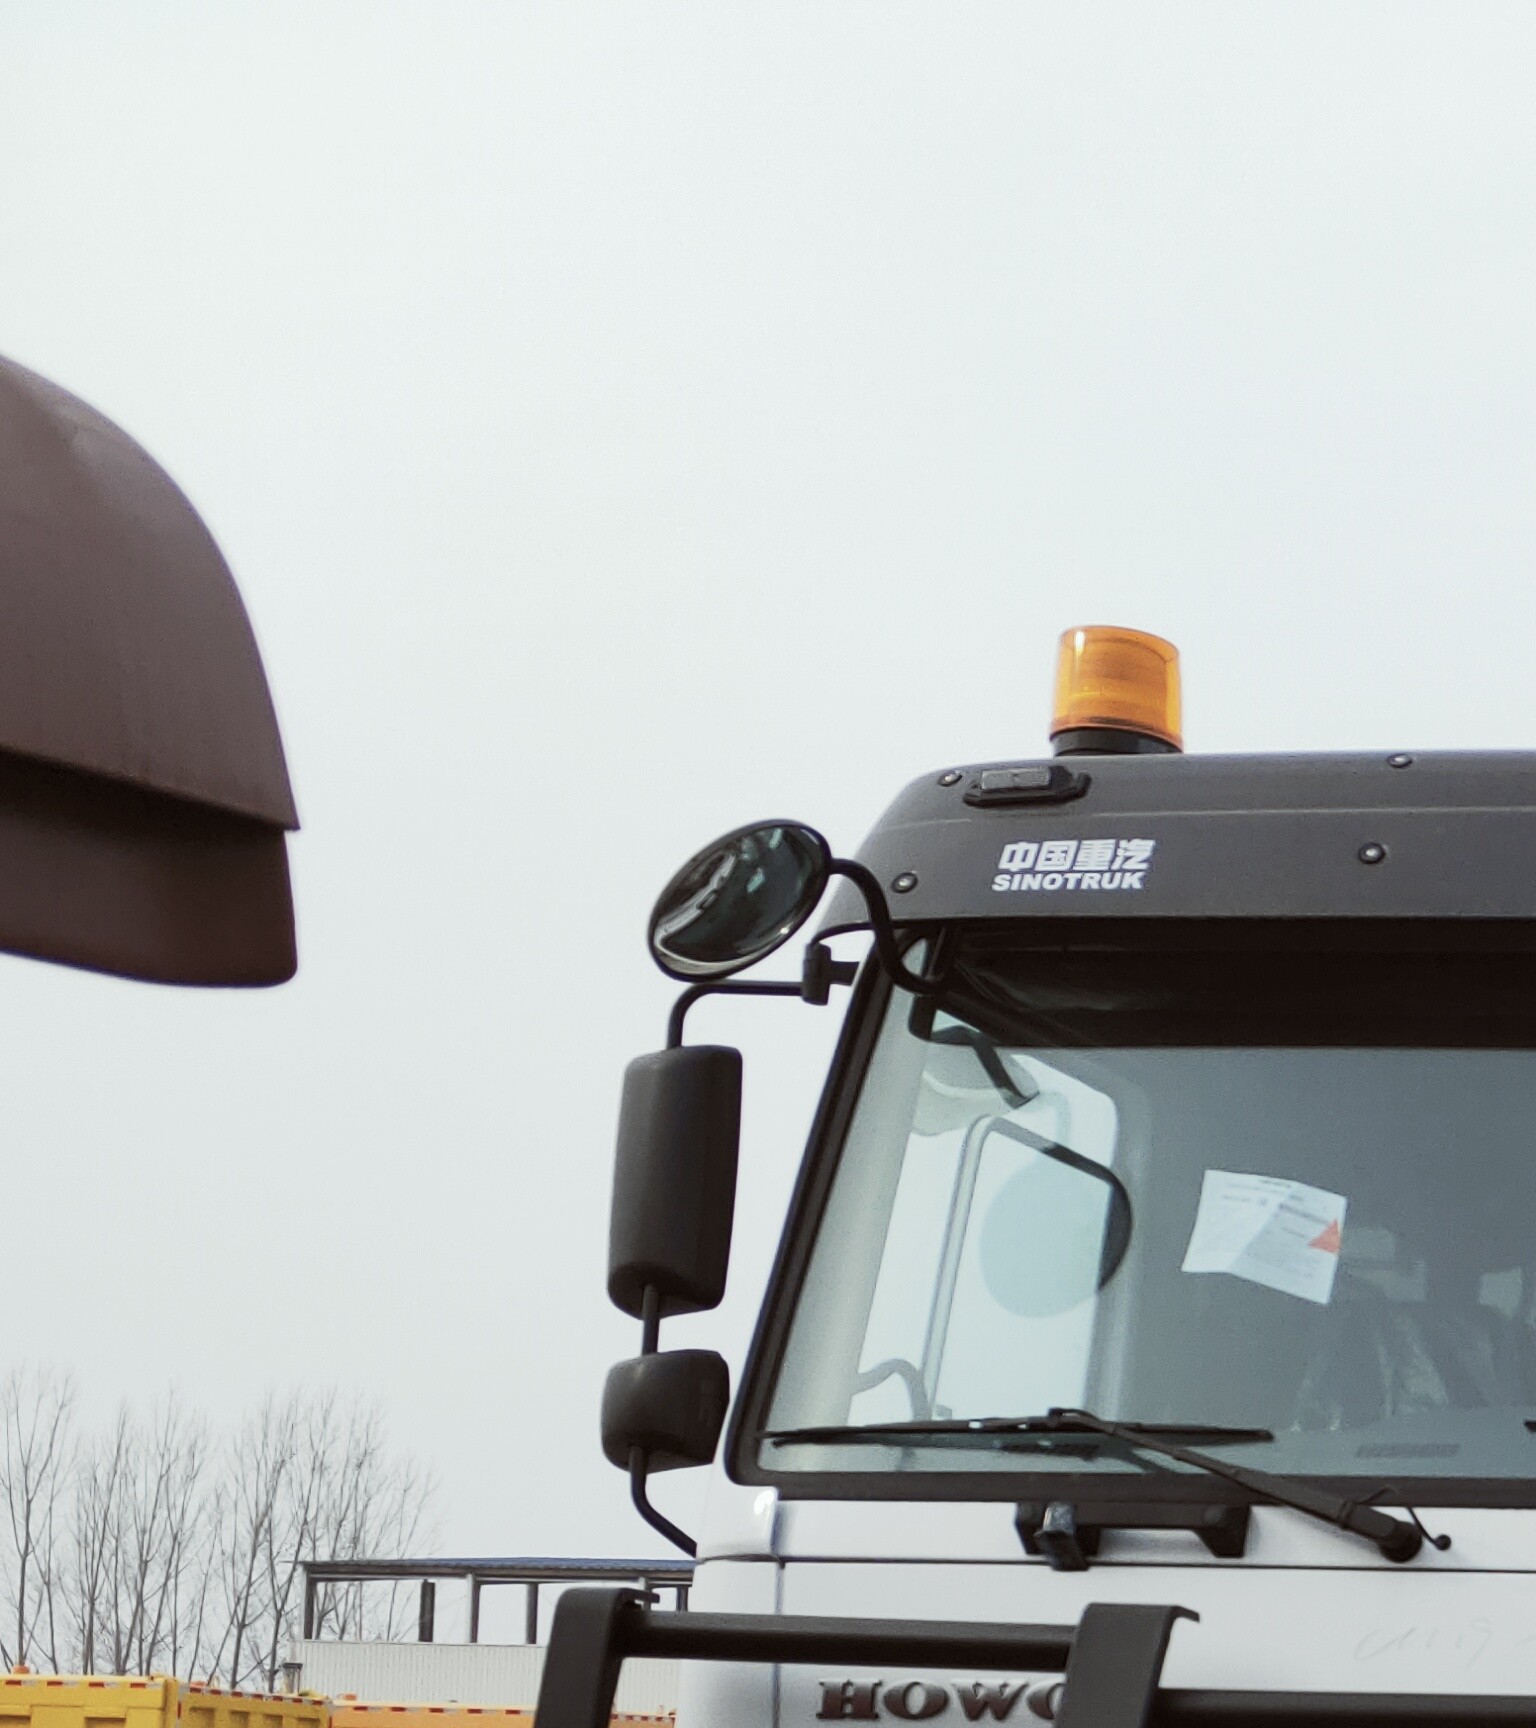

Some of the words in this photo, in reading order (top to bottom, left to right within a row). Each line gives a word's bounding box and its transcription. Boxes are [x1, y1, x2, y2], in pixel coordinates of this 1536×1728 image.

[997, 838, 1156, 872] 中国重汽
[991, 872, 1145, 892] SINOTRUK
